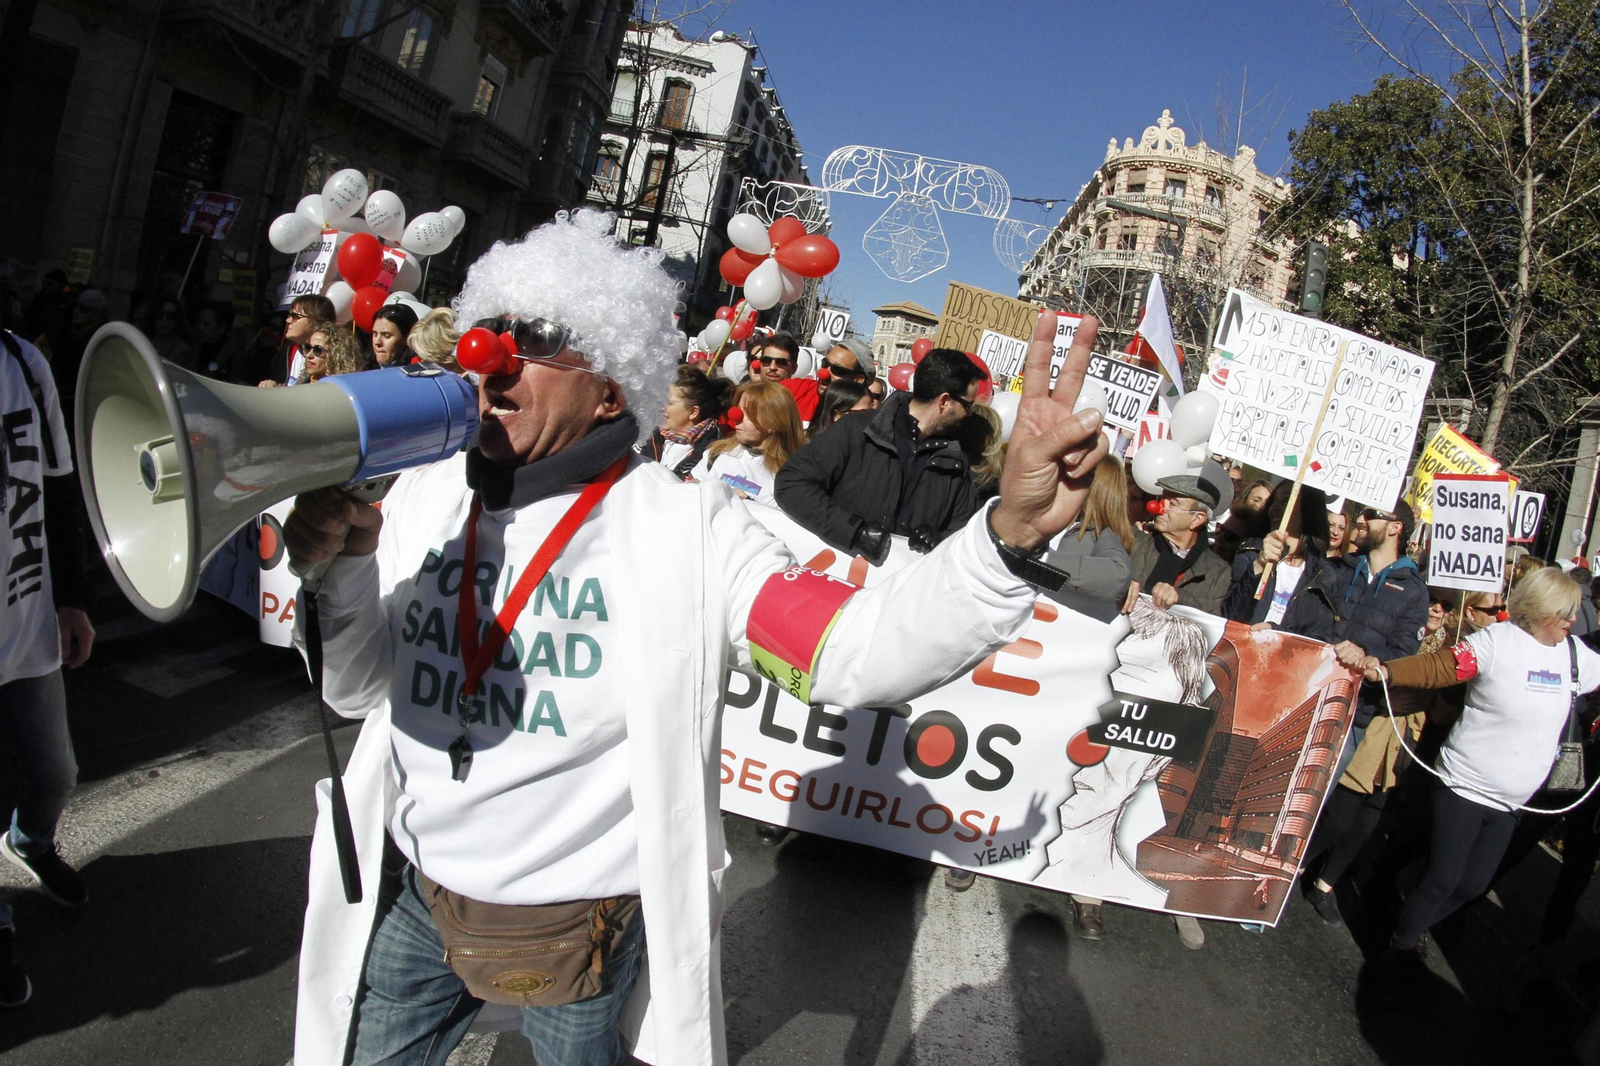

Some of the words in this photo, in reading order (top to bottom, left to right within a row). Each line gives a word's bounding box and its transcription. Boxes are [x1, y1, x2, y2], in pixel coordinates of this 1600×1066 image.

[818, 310, 846, 339] NO
[945, 283, 992, 325] TODOS
[987, 297, 1039, 341] SOMOS
[1268, 316, 1292, 343] DE
[1292, 321, 1341, 357] ENERO
[1345, 340, 1425, 387] GRANADA
[1087, 357, 1109, 378] SE
[1109, 363, 1158, 395] VENDE
[1228, 370, 1250, 398] SI
[1258, 378, 1278, 405] NO
[1231, 339, 1250, 365] 2
[1249, 344, 1334, 388] HOSPITALES
[1334, 368, 1408, 412] COMPLETOS
[1219, 399, 1314, 447] HOSPITALES
[1316, 430, 1406, 479] COMPLETOS
[1436, 485, 1506, 514] Susana,
[1434, 522, 1456, 540] no
[1461, 524, 1504, 545] sana
[415, 547, 499, 607] POR
[1431, 550, 1503, 578] ¡NADA!
[410, 659, 568, 738] DIGNA
[1119, 699, 1148, 721] TU
[1104, 723, 1177, 751] SALUD
[973, 839, 1032, 868] YEAH!
